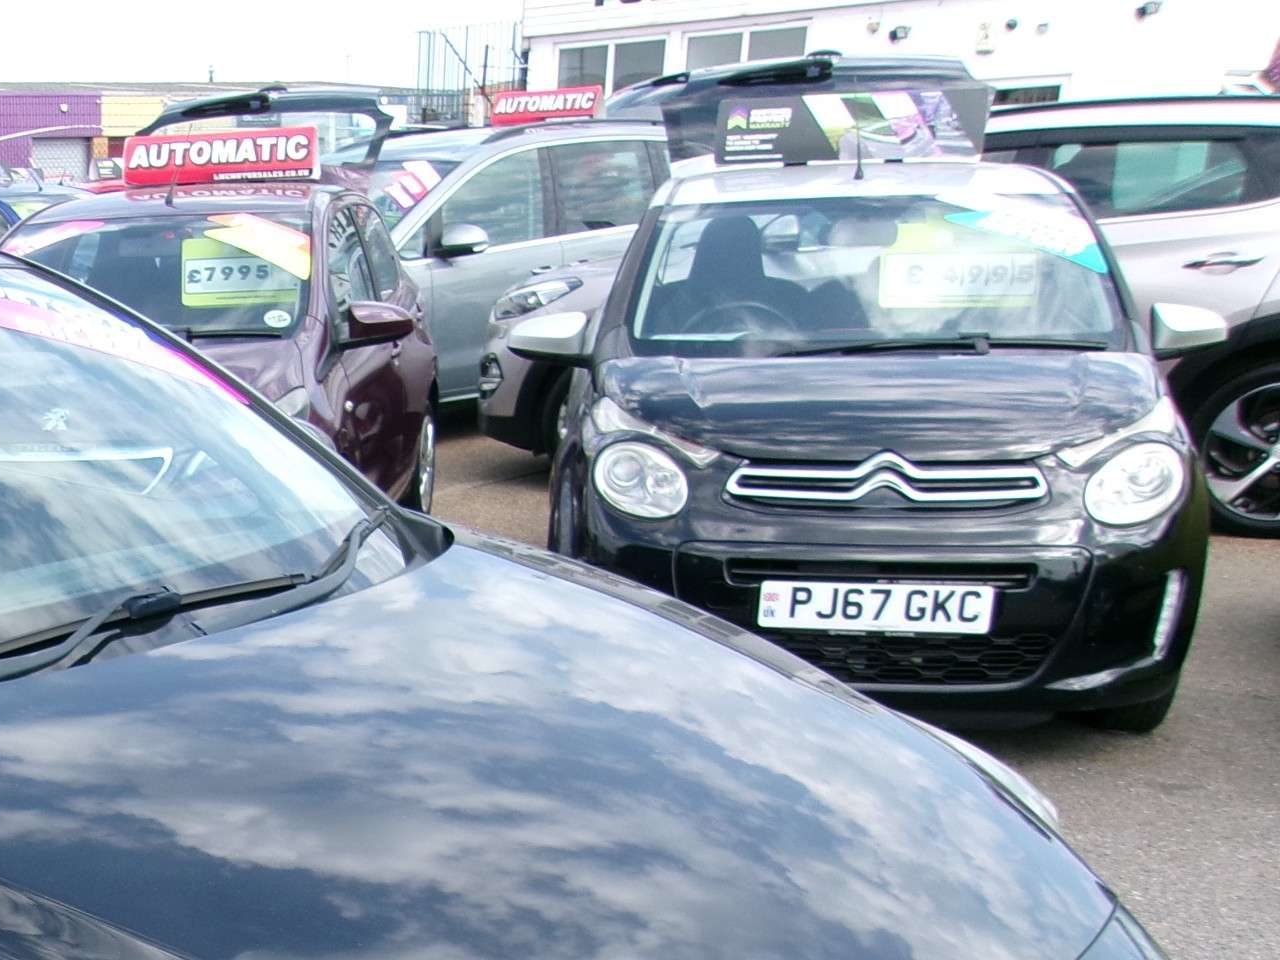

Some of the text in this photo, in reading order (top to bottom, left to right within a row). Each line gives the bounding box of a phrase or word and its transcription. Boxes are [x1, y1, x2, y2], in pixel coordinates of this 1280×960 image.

[494, 92, 595, 114] AUTOMATIC
[128, 134, 309, 169] AUTOMATIC
[186, 264, 270, 284] £7995
[789, 587, 982, 623] PJ67 GKC
